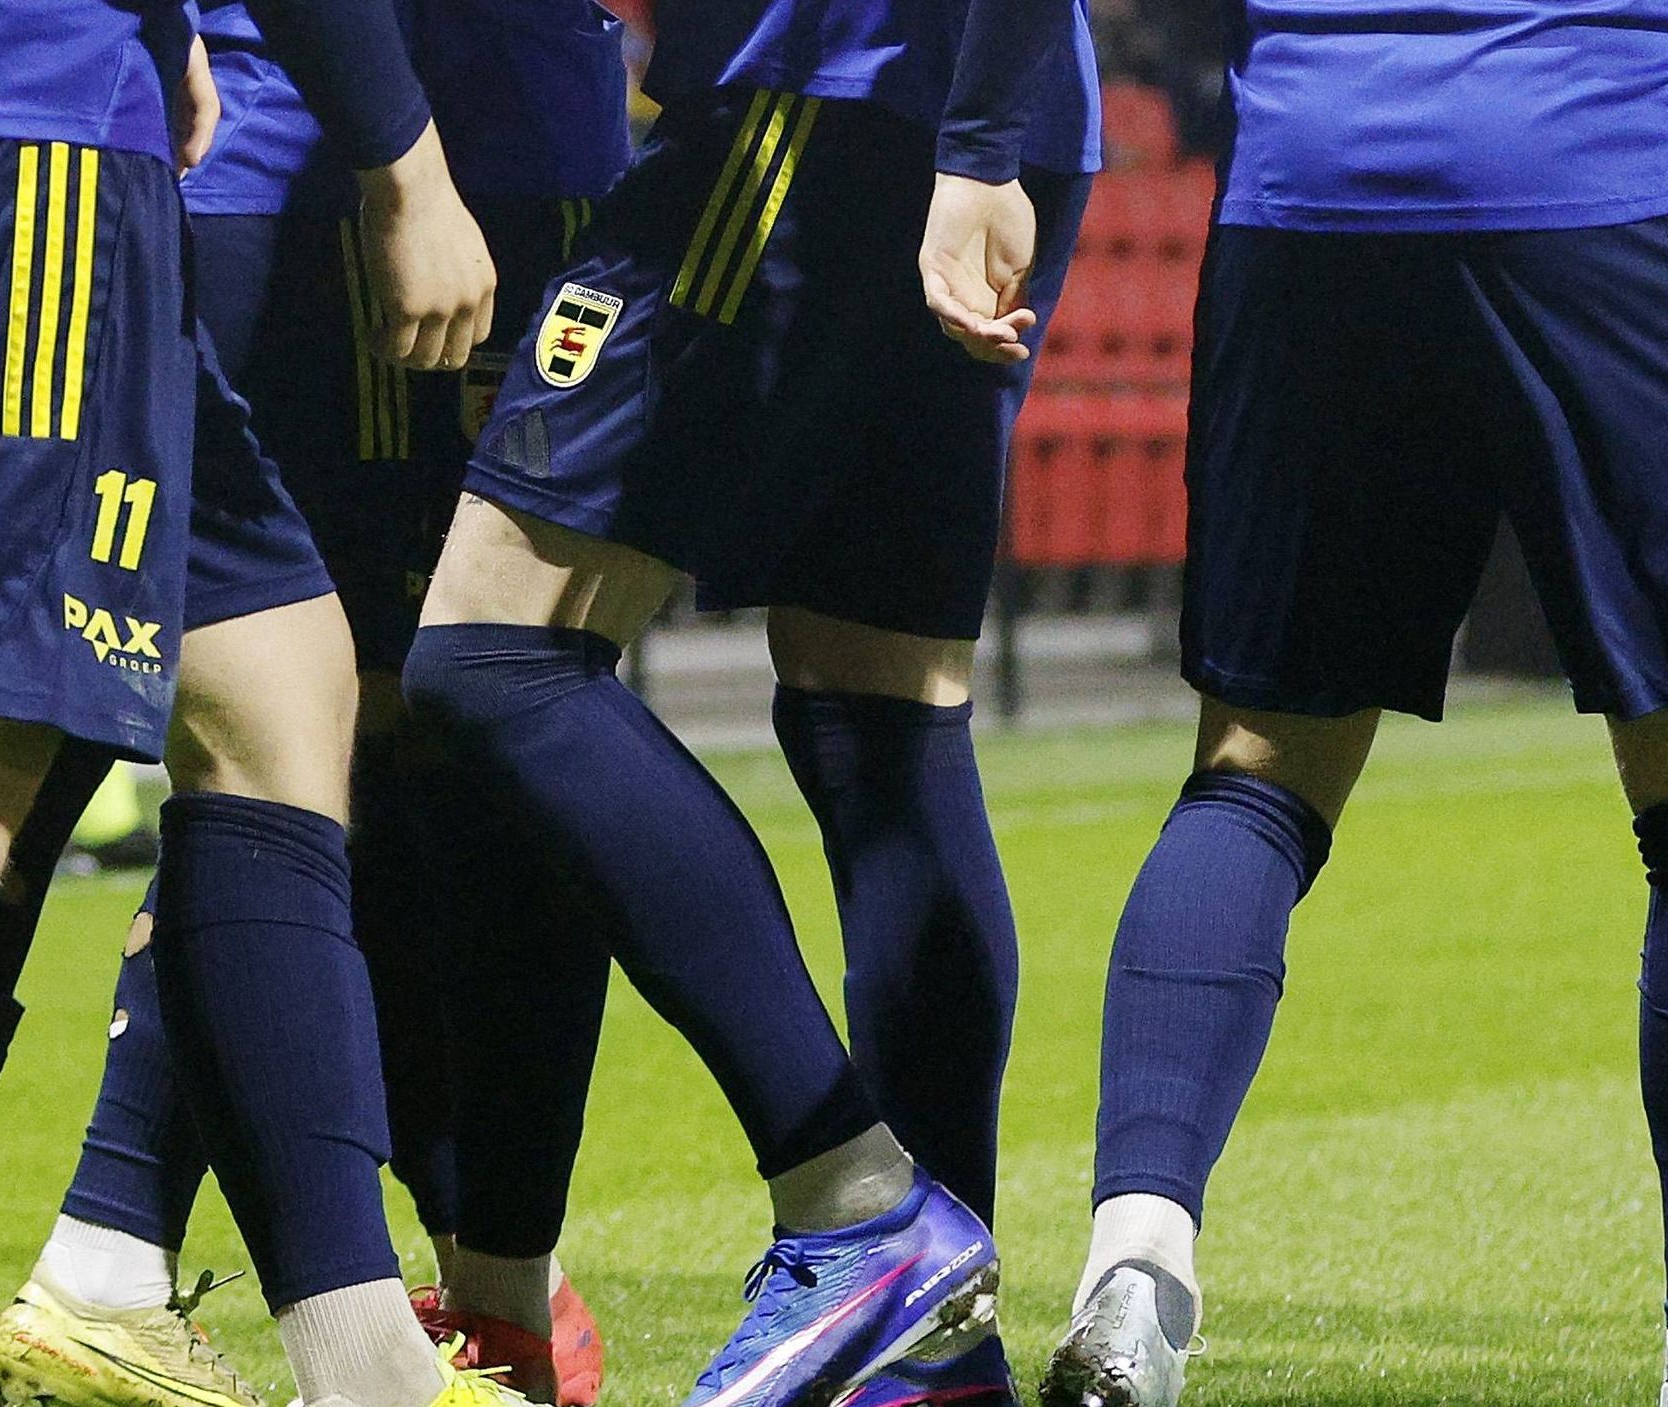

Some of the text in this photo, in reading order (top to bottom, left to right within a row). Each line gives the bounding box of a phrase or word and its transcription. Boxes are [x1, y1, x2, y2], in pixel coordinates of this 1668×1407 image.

[574, 287, 621, 309] CAMBUUR
[90, 469, 157, 571] 11
[64, 592, 162, 664] PAX
